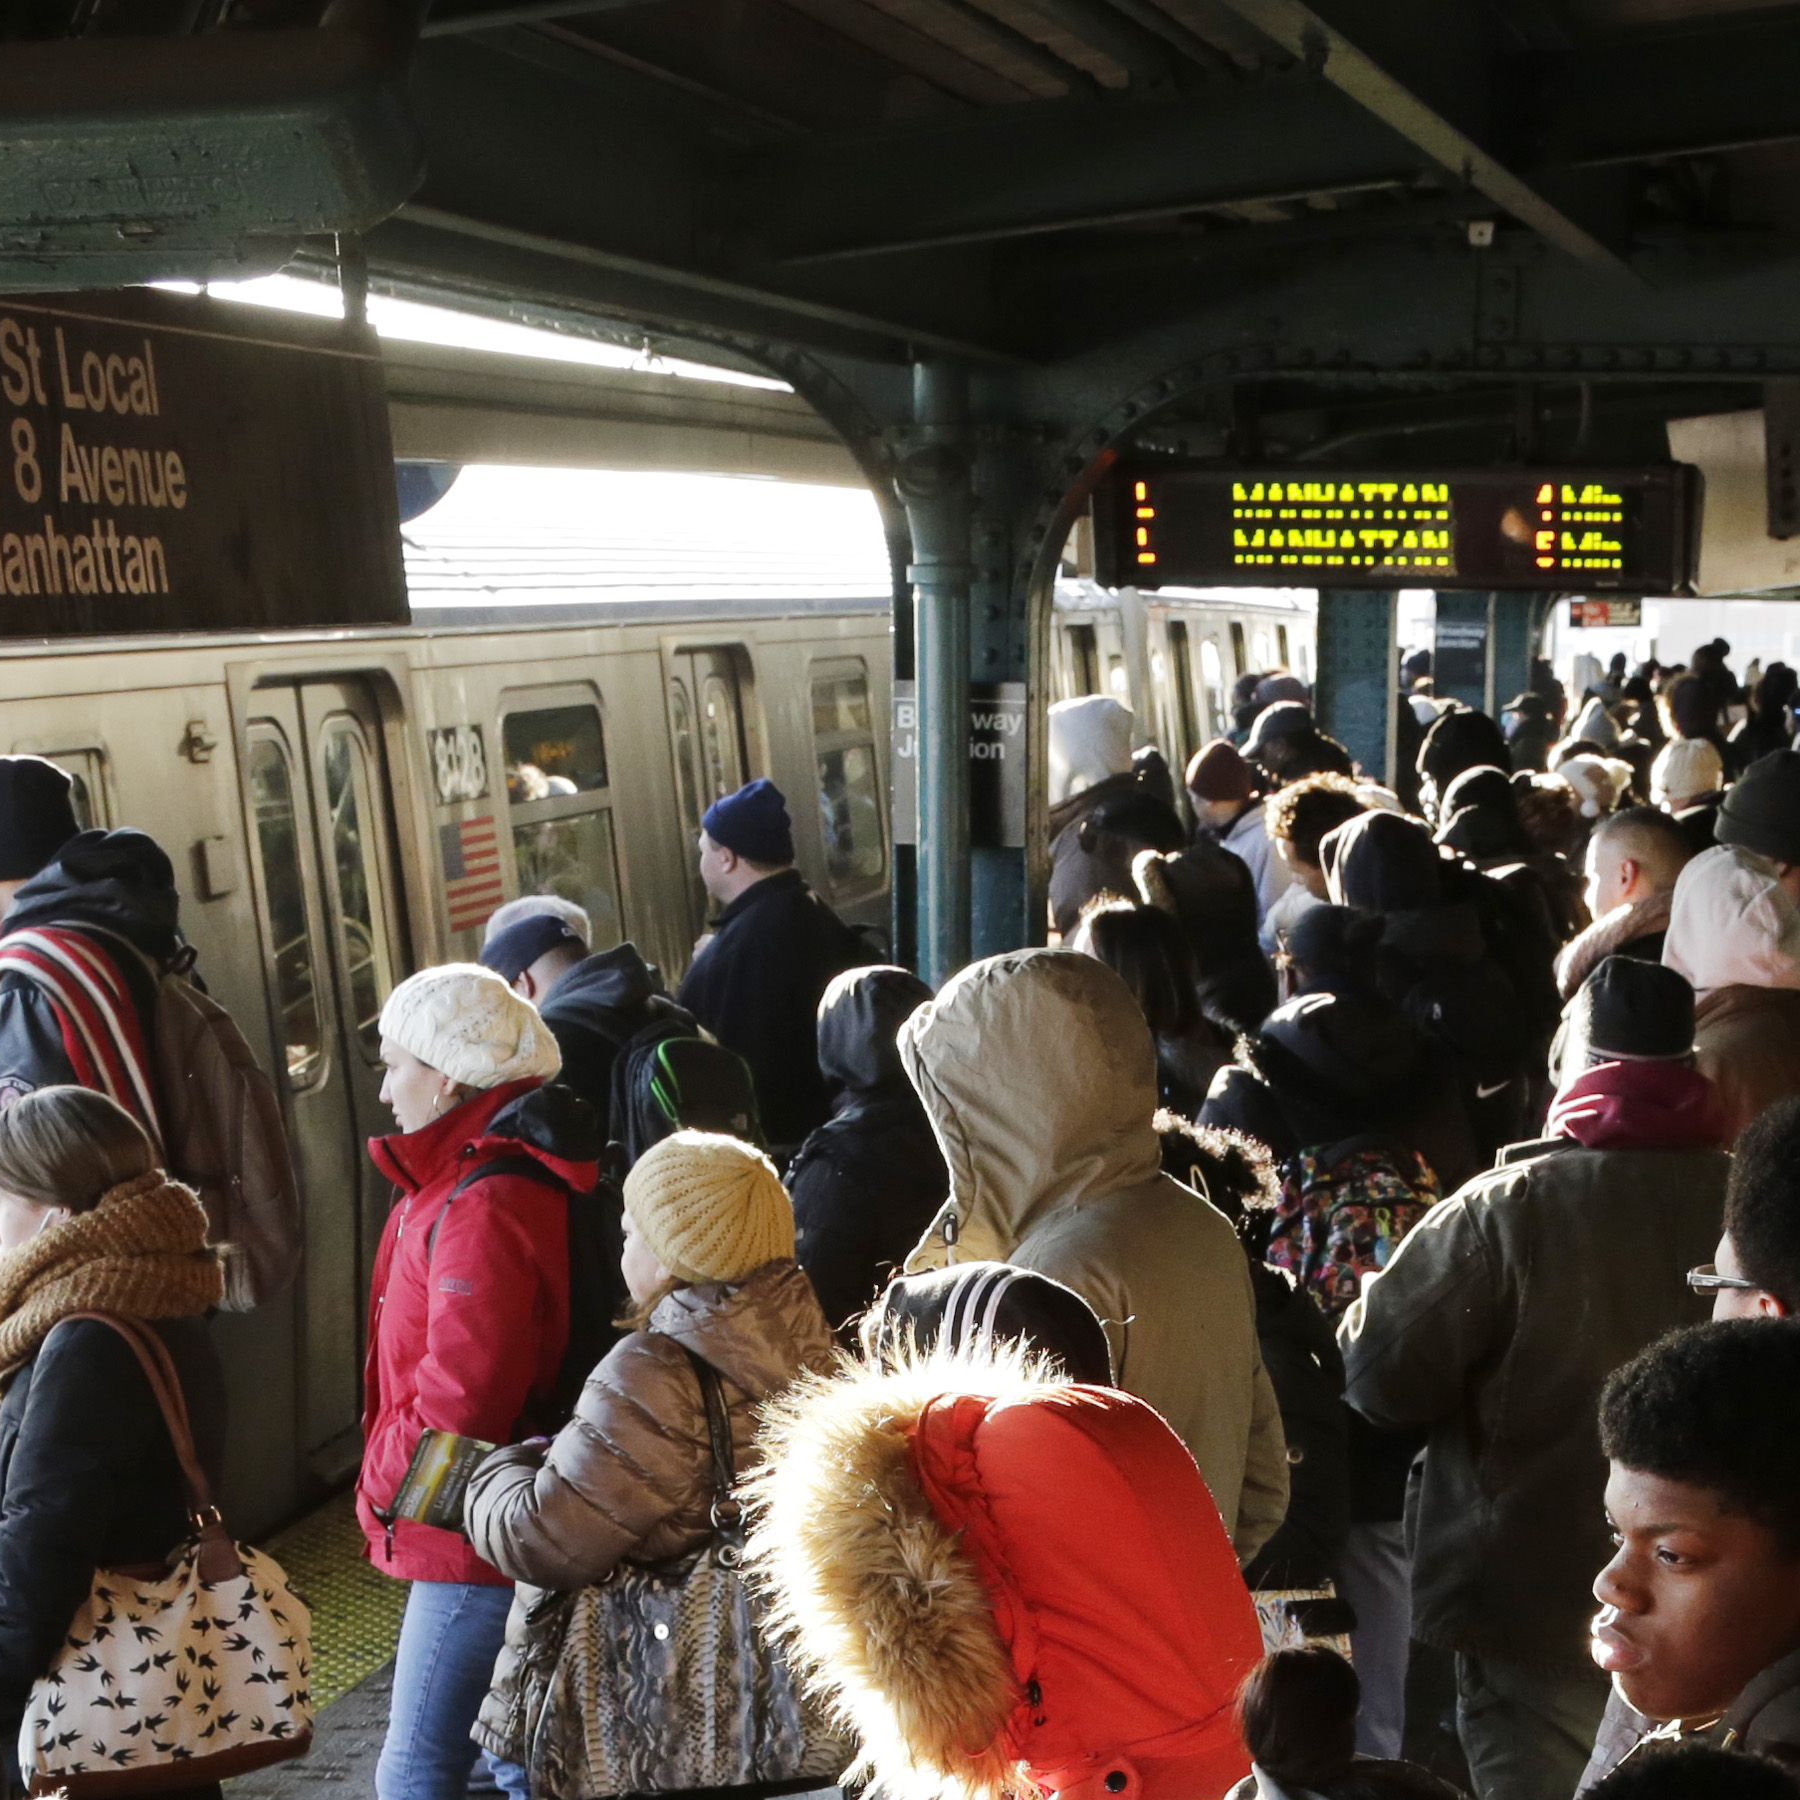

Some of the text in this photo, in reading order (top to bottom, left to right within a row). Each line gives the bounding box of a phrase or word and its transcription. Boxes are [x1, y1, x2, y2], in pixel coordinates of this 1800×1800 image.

[55, 327, 160, 416] Local
[11, 417, 42, 503] 8
[59, 423, 187, 510] Avenue
[1233, 483, 1448, 519] MANHATTAN
[1234, 529, 1448, 566] MANHATTAN
